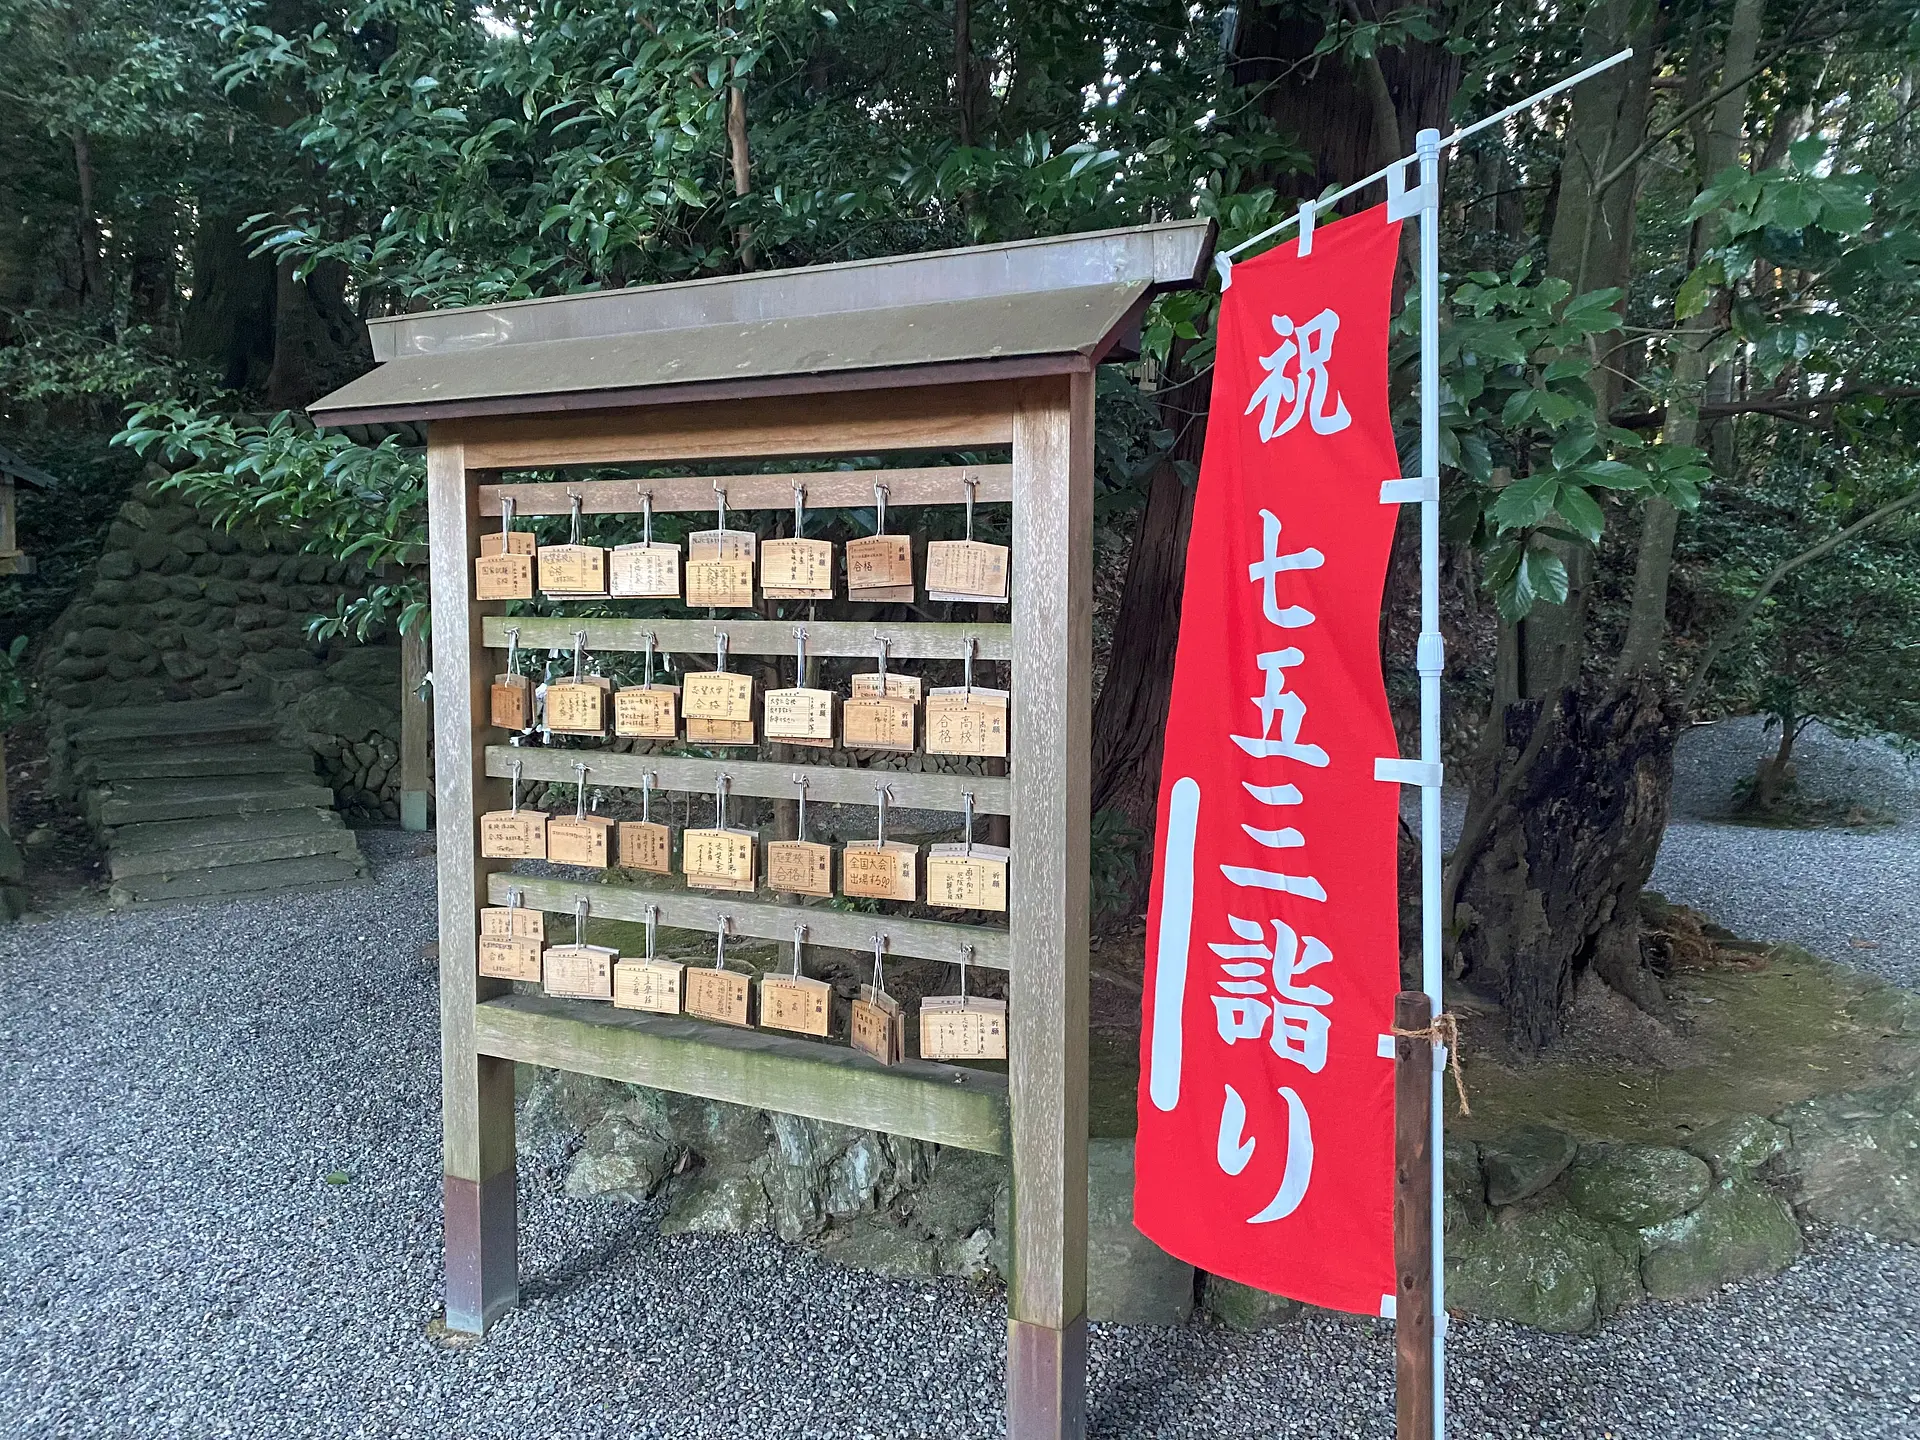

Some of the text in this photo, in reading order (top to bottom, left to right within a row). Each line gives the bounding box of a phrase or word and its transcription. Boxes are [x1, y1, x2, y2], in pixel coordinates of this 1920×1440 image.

[852, 560, 873, 573] 合格
[818, 702, 827, 718] 祈願
[901, 711, 910, 728] 祈願
[936, 713, 953, 744] 合格
[991, 717, 1001, 735] 祈願
[959, 715, 974, 745] 高校
[1206, 307, 1351, 1225] 祝 七五三詣り
[849, 856, 889, 871] 全国大会
[902, 861, 911, 878] 祈願
[991, 871, 1001, 889] 祈願
[990, 1018, 1000, 1036] 祈願
